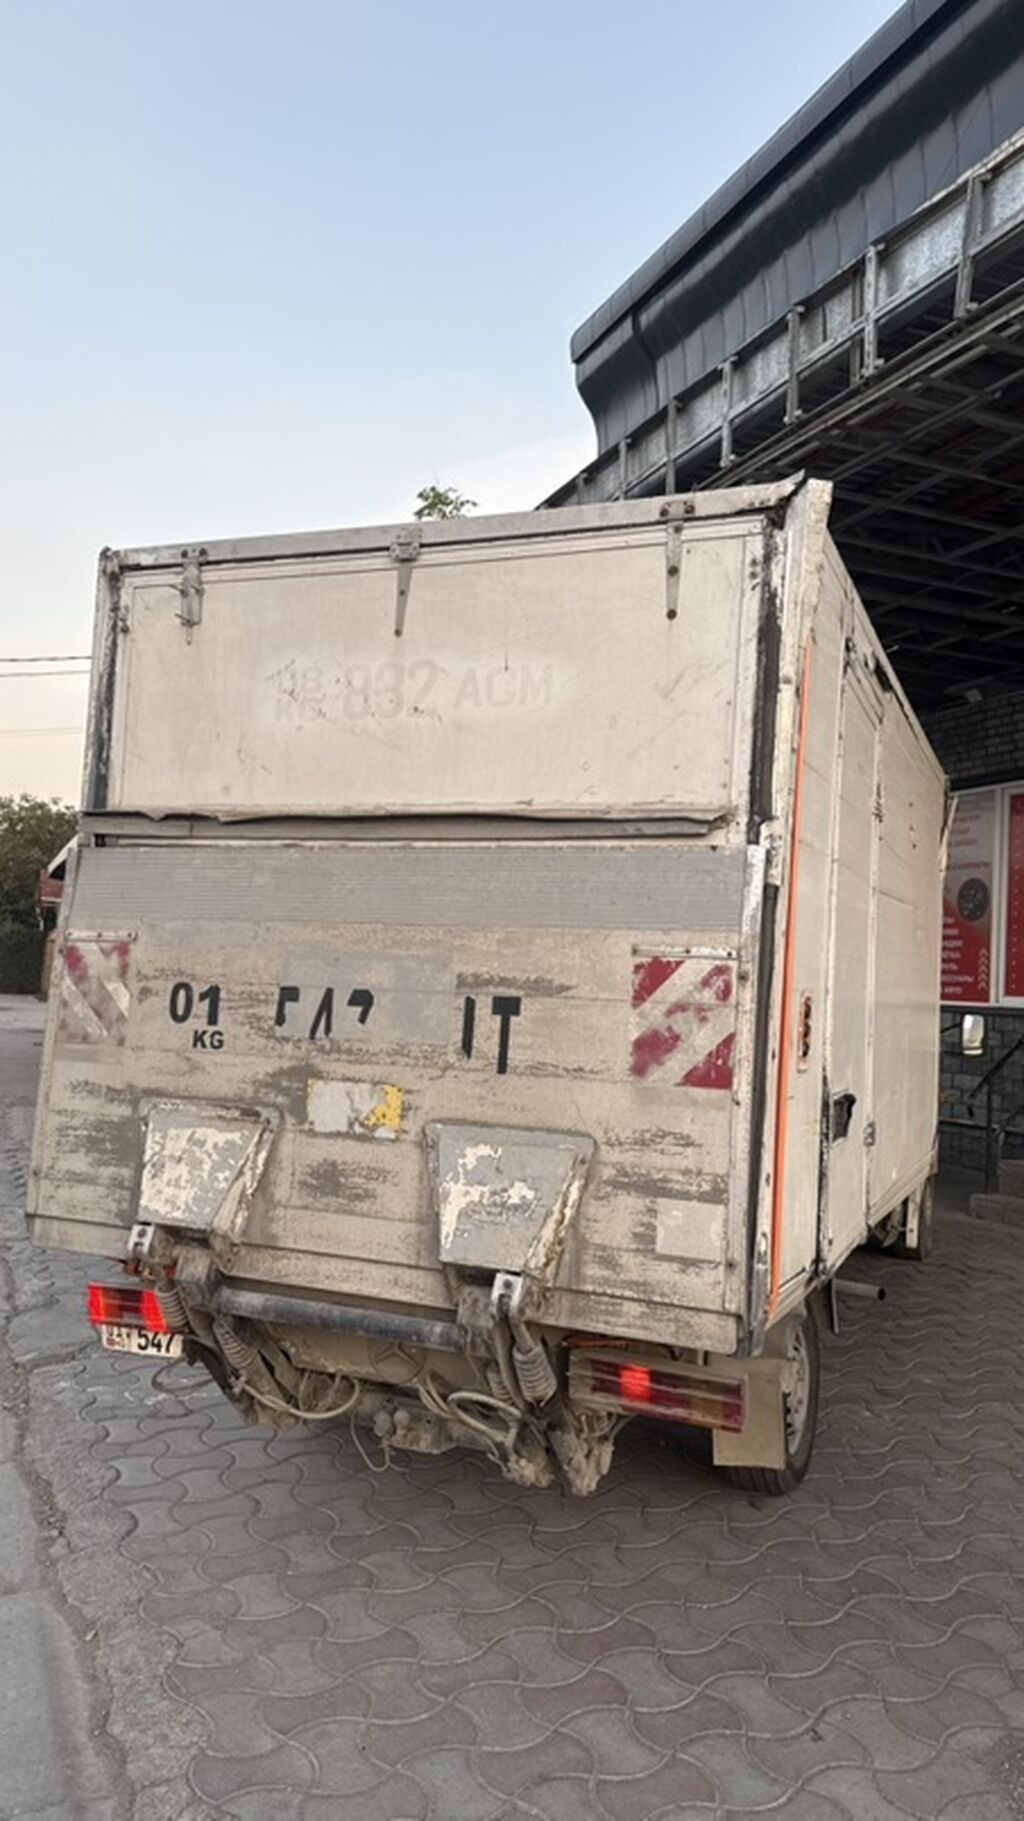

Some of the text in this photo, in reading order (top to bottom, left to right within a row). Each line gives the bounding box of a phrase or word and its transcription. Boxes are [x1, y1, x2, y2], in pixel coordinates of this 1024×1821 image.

[168, 981, 222, 1026] 01
[191, 1030, 225, 1050] KG
[137, 1327, 176, 1354] 547
